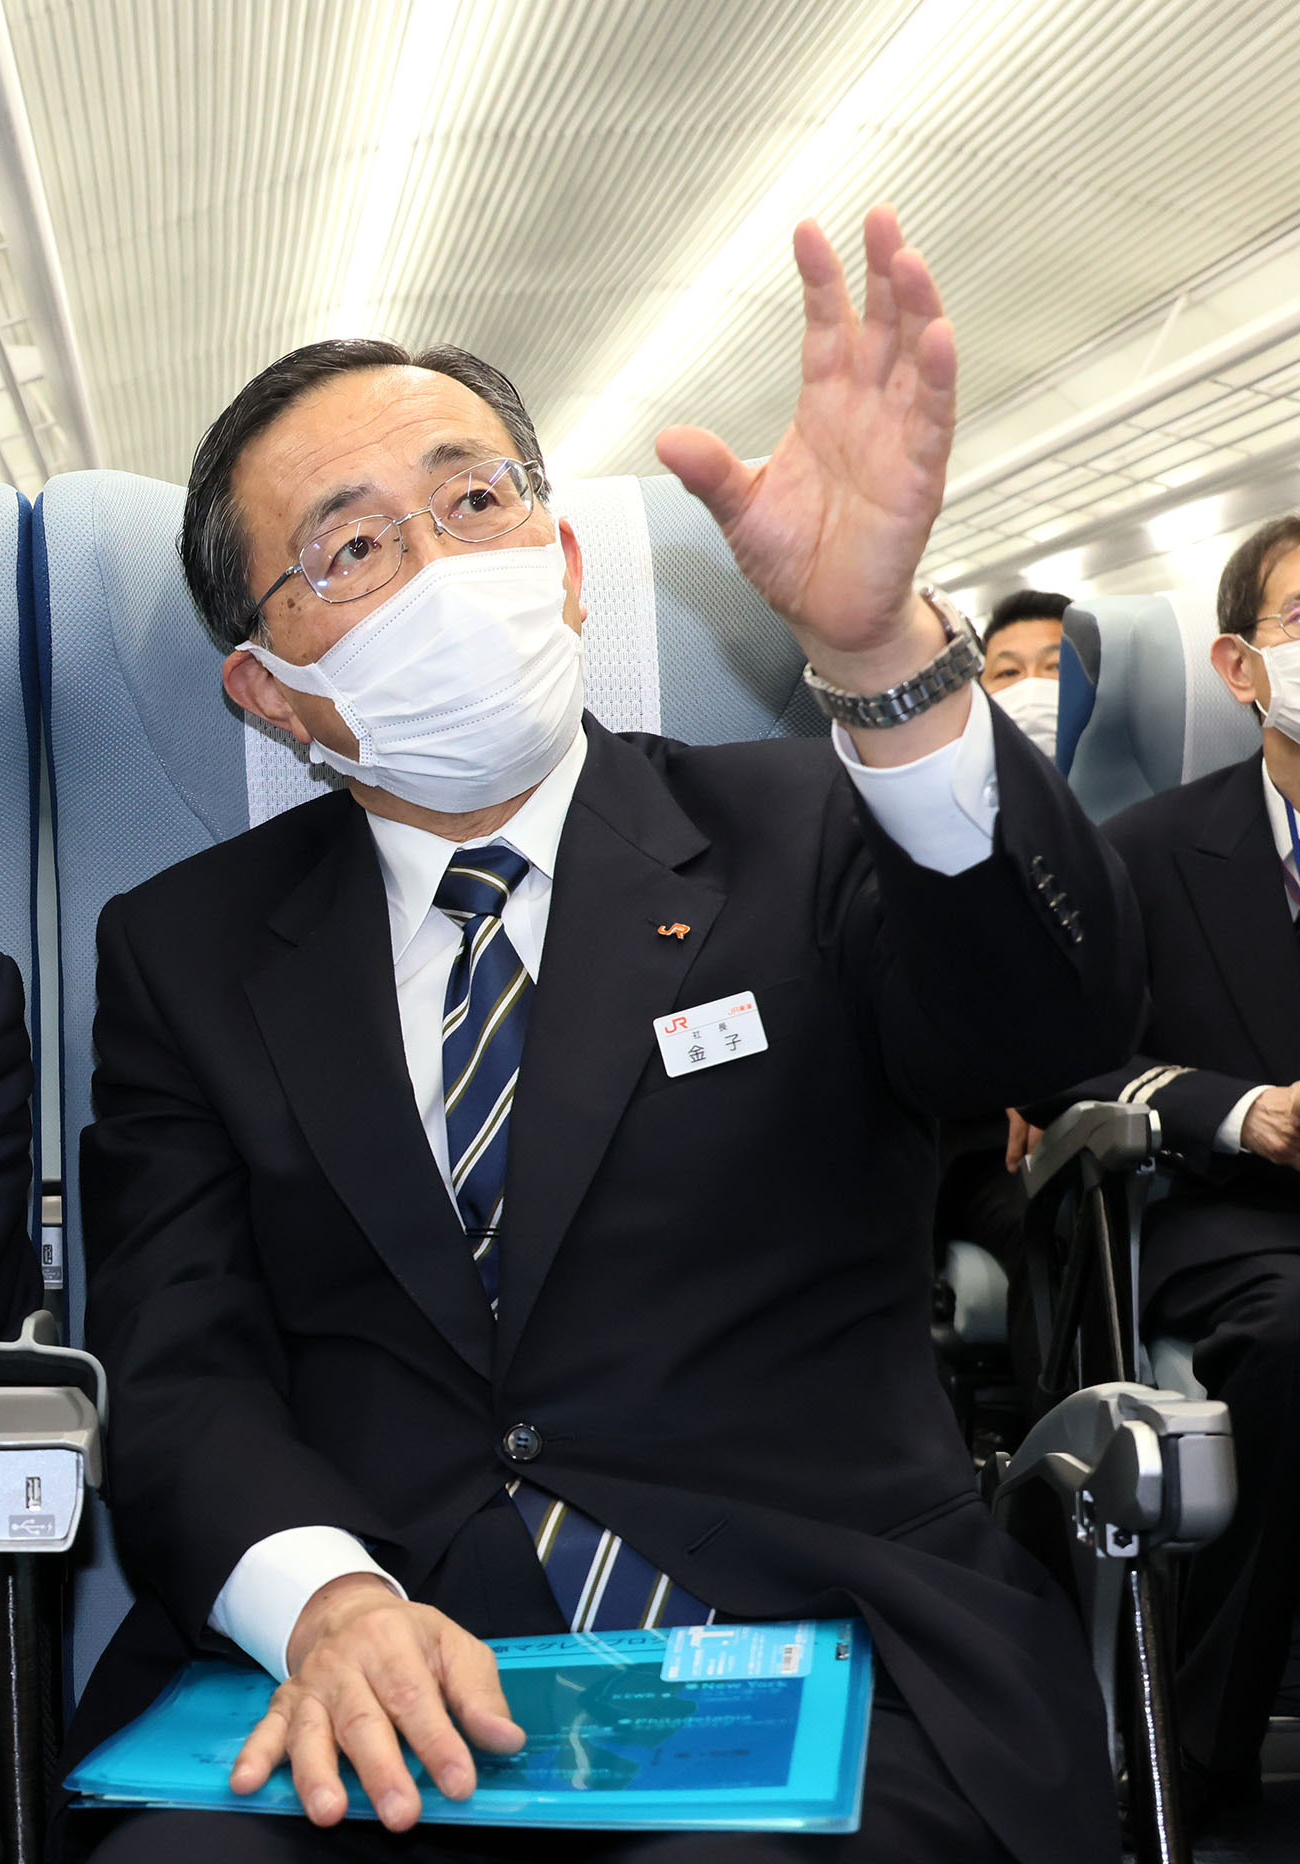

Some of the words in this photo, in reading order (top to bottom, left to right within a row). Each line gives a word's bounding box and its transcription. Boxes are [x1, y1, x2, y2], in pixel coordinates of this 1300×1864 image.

[657, 922, 691, 939] JR
[664, 1016, 688, 1034] JR
[688, 1033, 742, 1063] 金子
